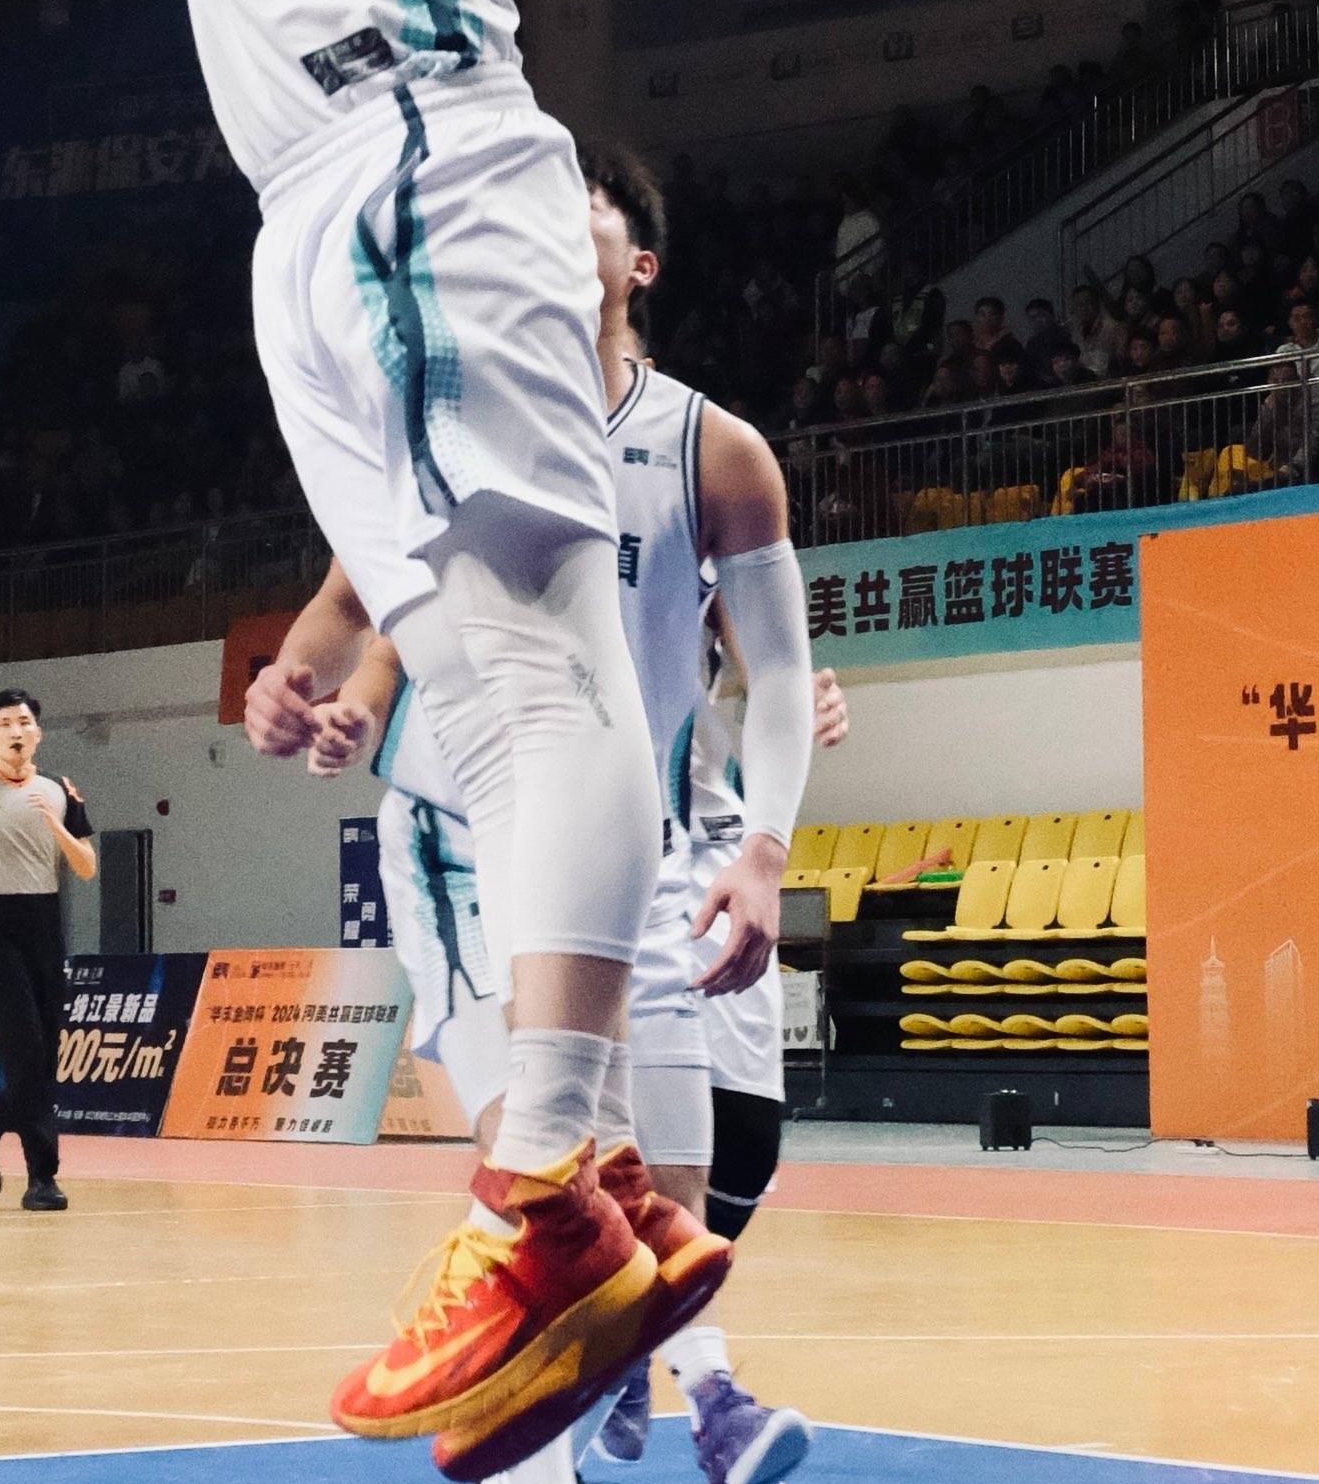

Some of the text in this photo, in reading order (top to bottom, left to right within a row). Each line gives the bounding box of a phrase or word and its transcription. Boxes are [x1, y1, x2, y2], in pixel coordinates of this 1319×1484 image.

[808, 541, 1135, 639] 美共赢篮球联赛
[216, 1037, 358, 1098] 总决赛
